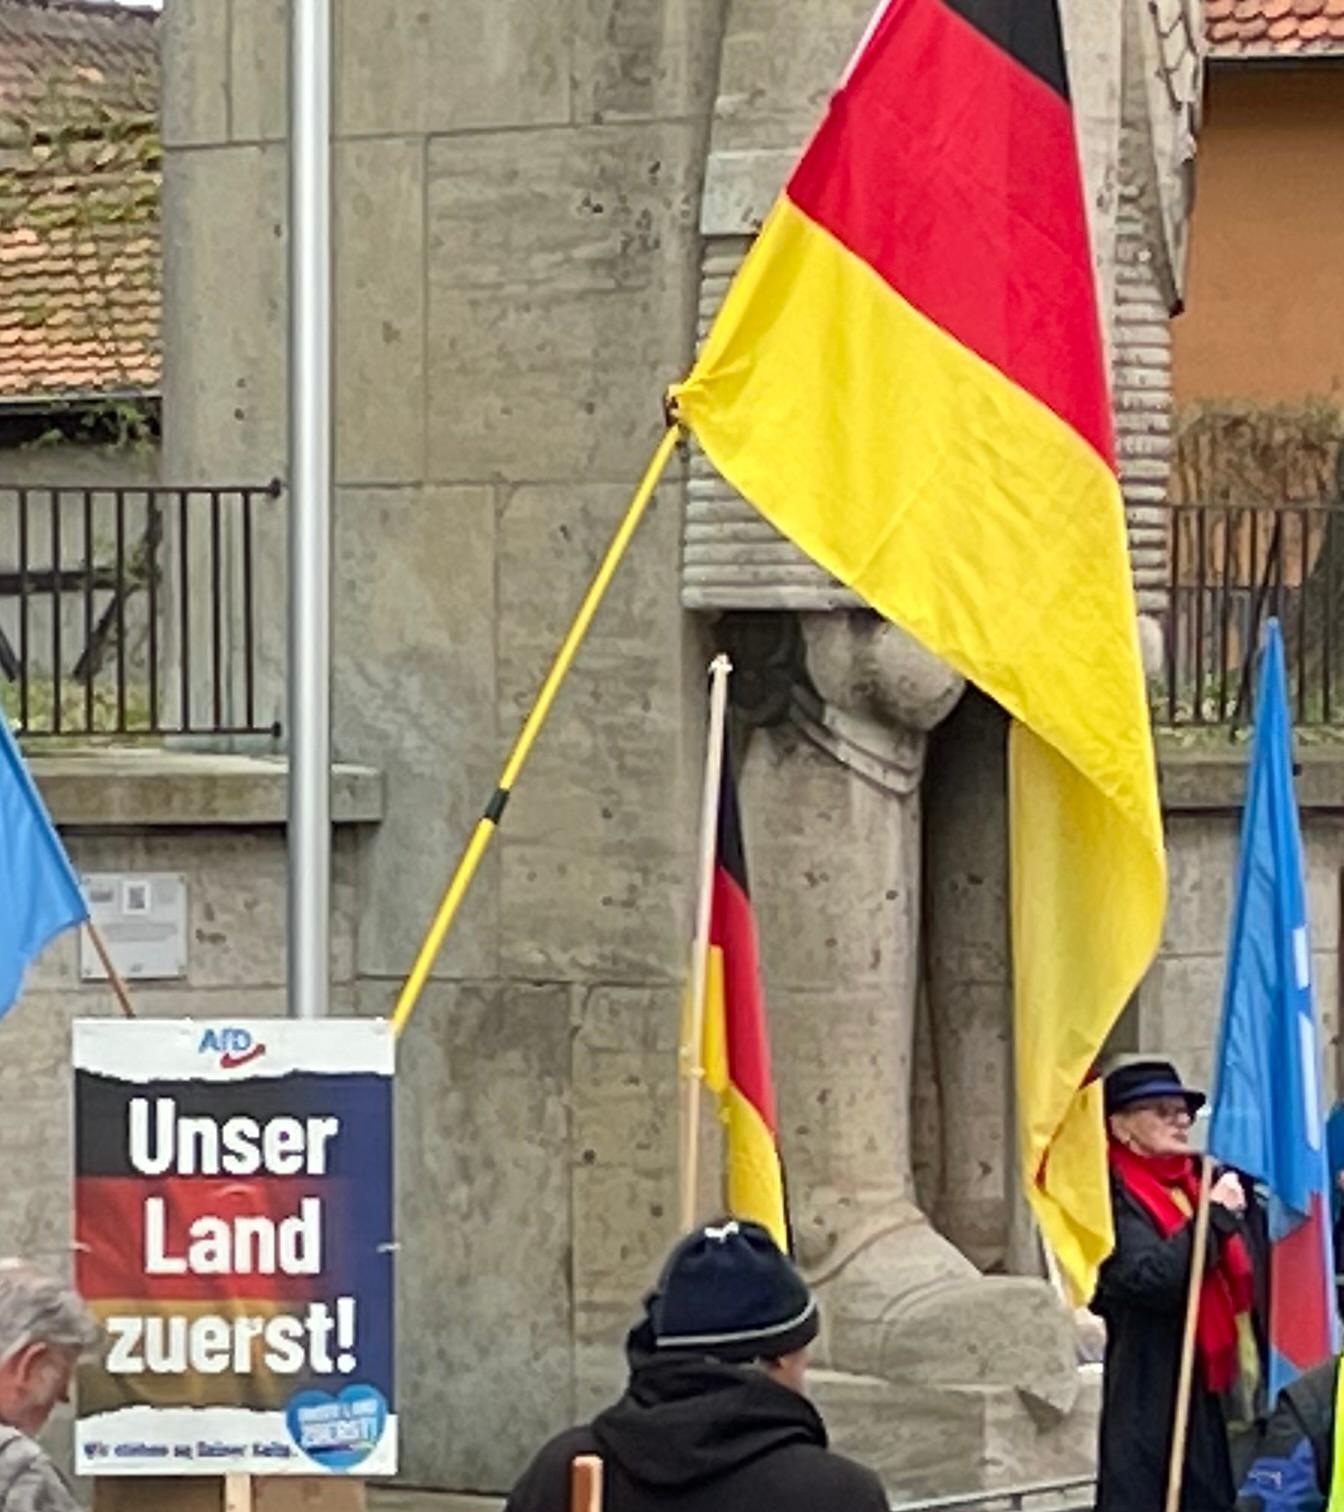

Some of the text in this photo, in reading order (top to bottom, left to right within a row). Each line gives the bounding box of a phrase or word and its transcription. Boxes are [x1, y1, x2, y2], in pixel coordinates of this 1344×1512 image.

[198, 1027, 252, 1054] AfD
[128, 1097, 339, 1176] Unser
[143, 1197, 322, 1275] Land
[105, 1297, 357, 1374] zuerst!
